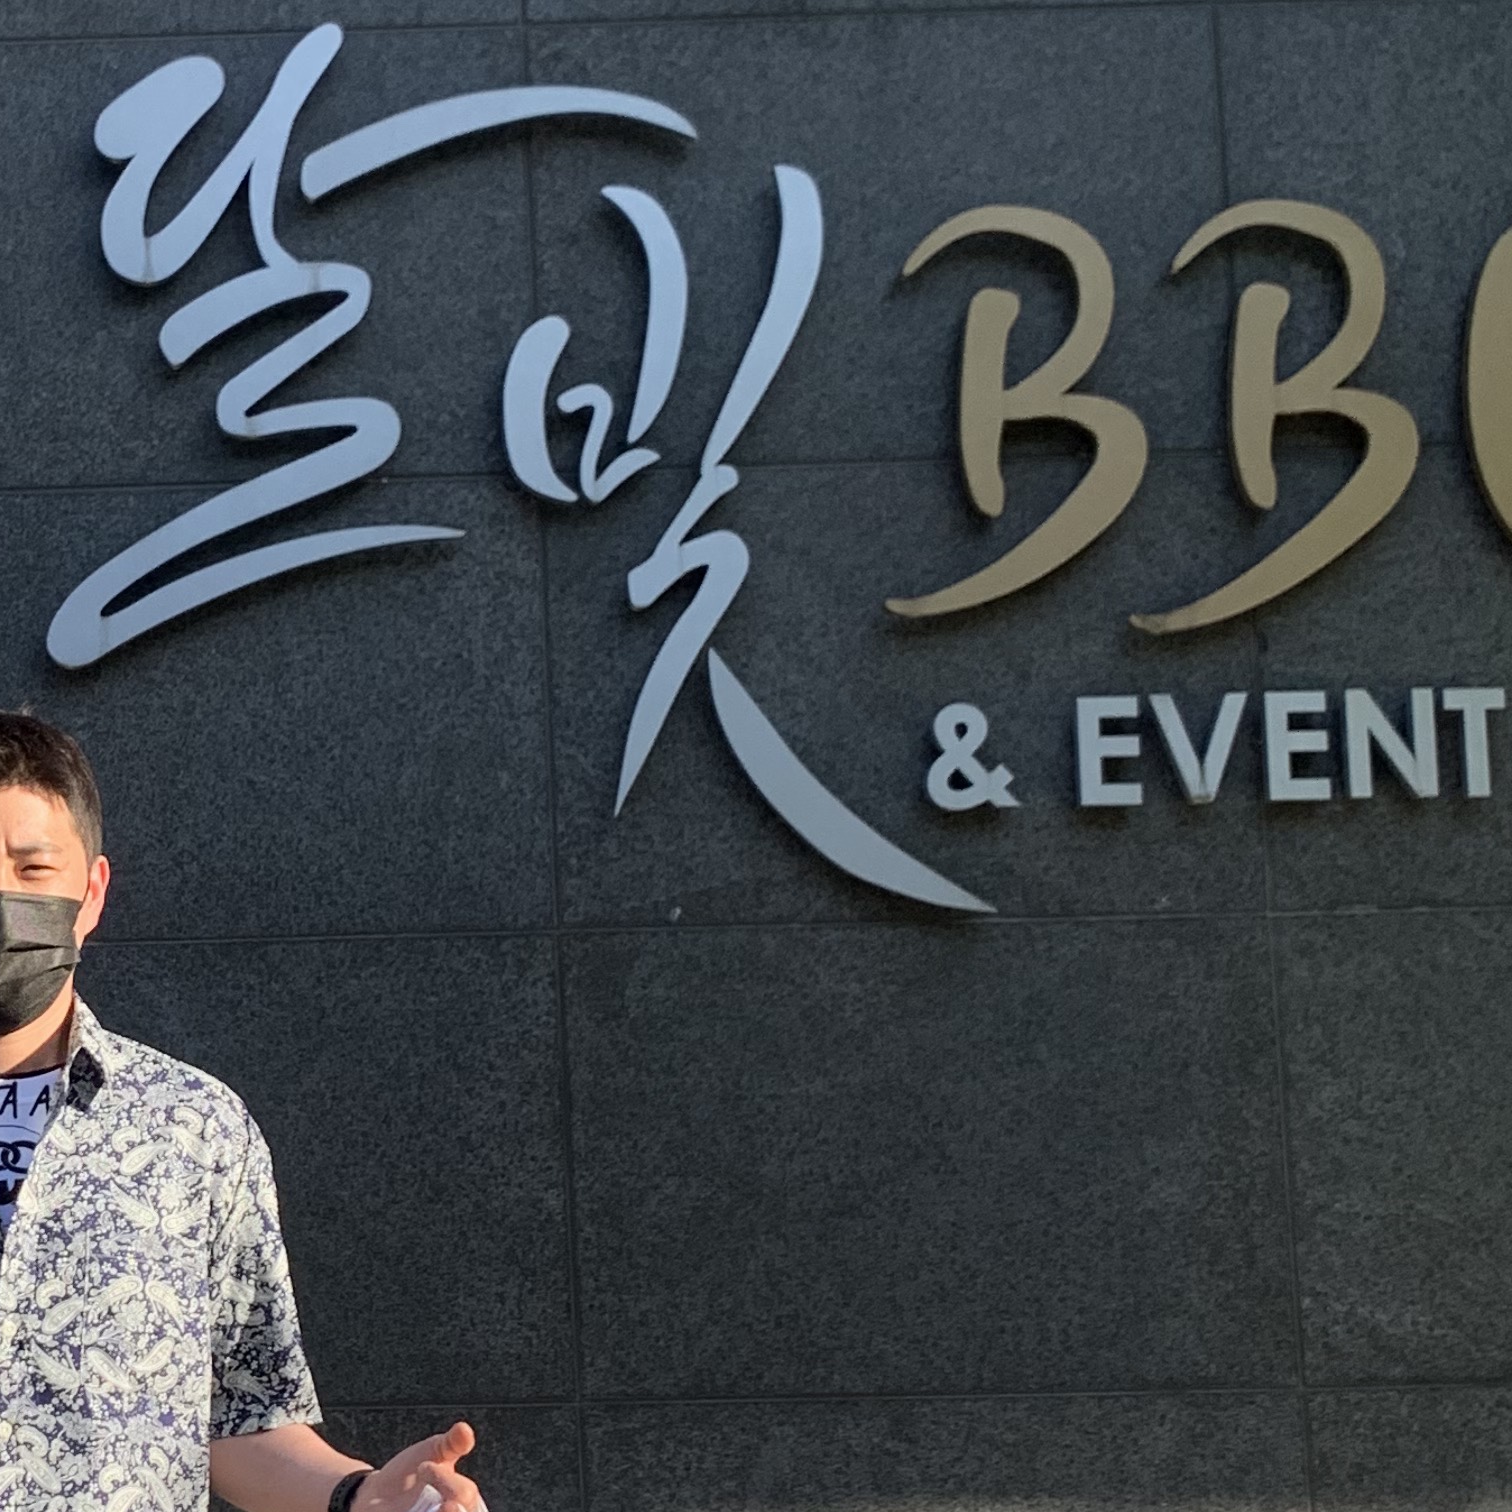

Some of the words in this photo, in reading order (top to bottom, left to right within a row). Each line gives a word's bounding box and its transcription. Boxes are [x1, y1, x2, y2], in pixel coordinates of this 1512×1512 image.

[886, 199, 1512, 635] BB
[925, 702, 1021, 811] &
[1077, 687, 1506, 806] EVENT
